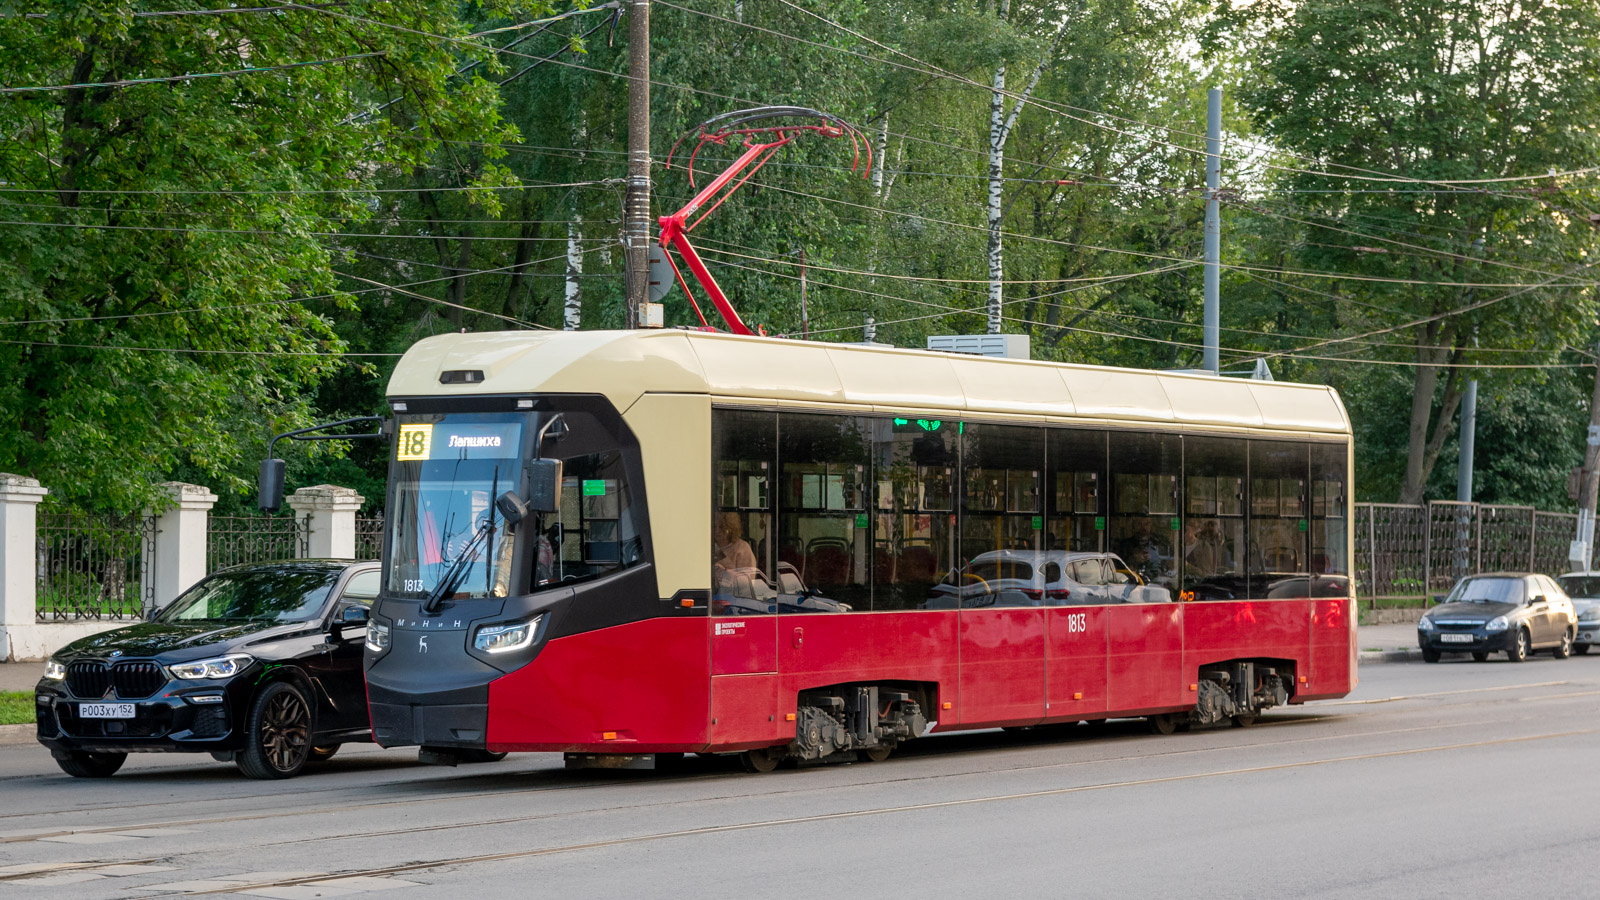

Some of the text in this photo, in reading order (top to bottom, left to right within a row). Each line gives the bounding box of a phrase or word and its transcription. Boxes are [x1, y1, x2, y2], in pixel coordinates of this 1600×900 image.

[404, 431, 501, 455] 18 Лапшиха
[404, 579, 423, 592] 1813
[1068, 613, 1086, 632] 1813
[119, 705, 132, 713] 152
